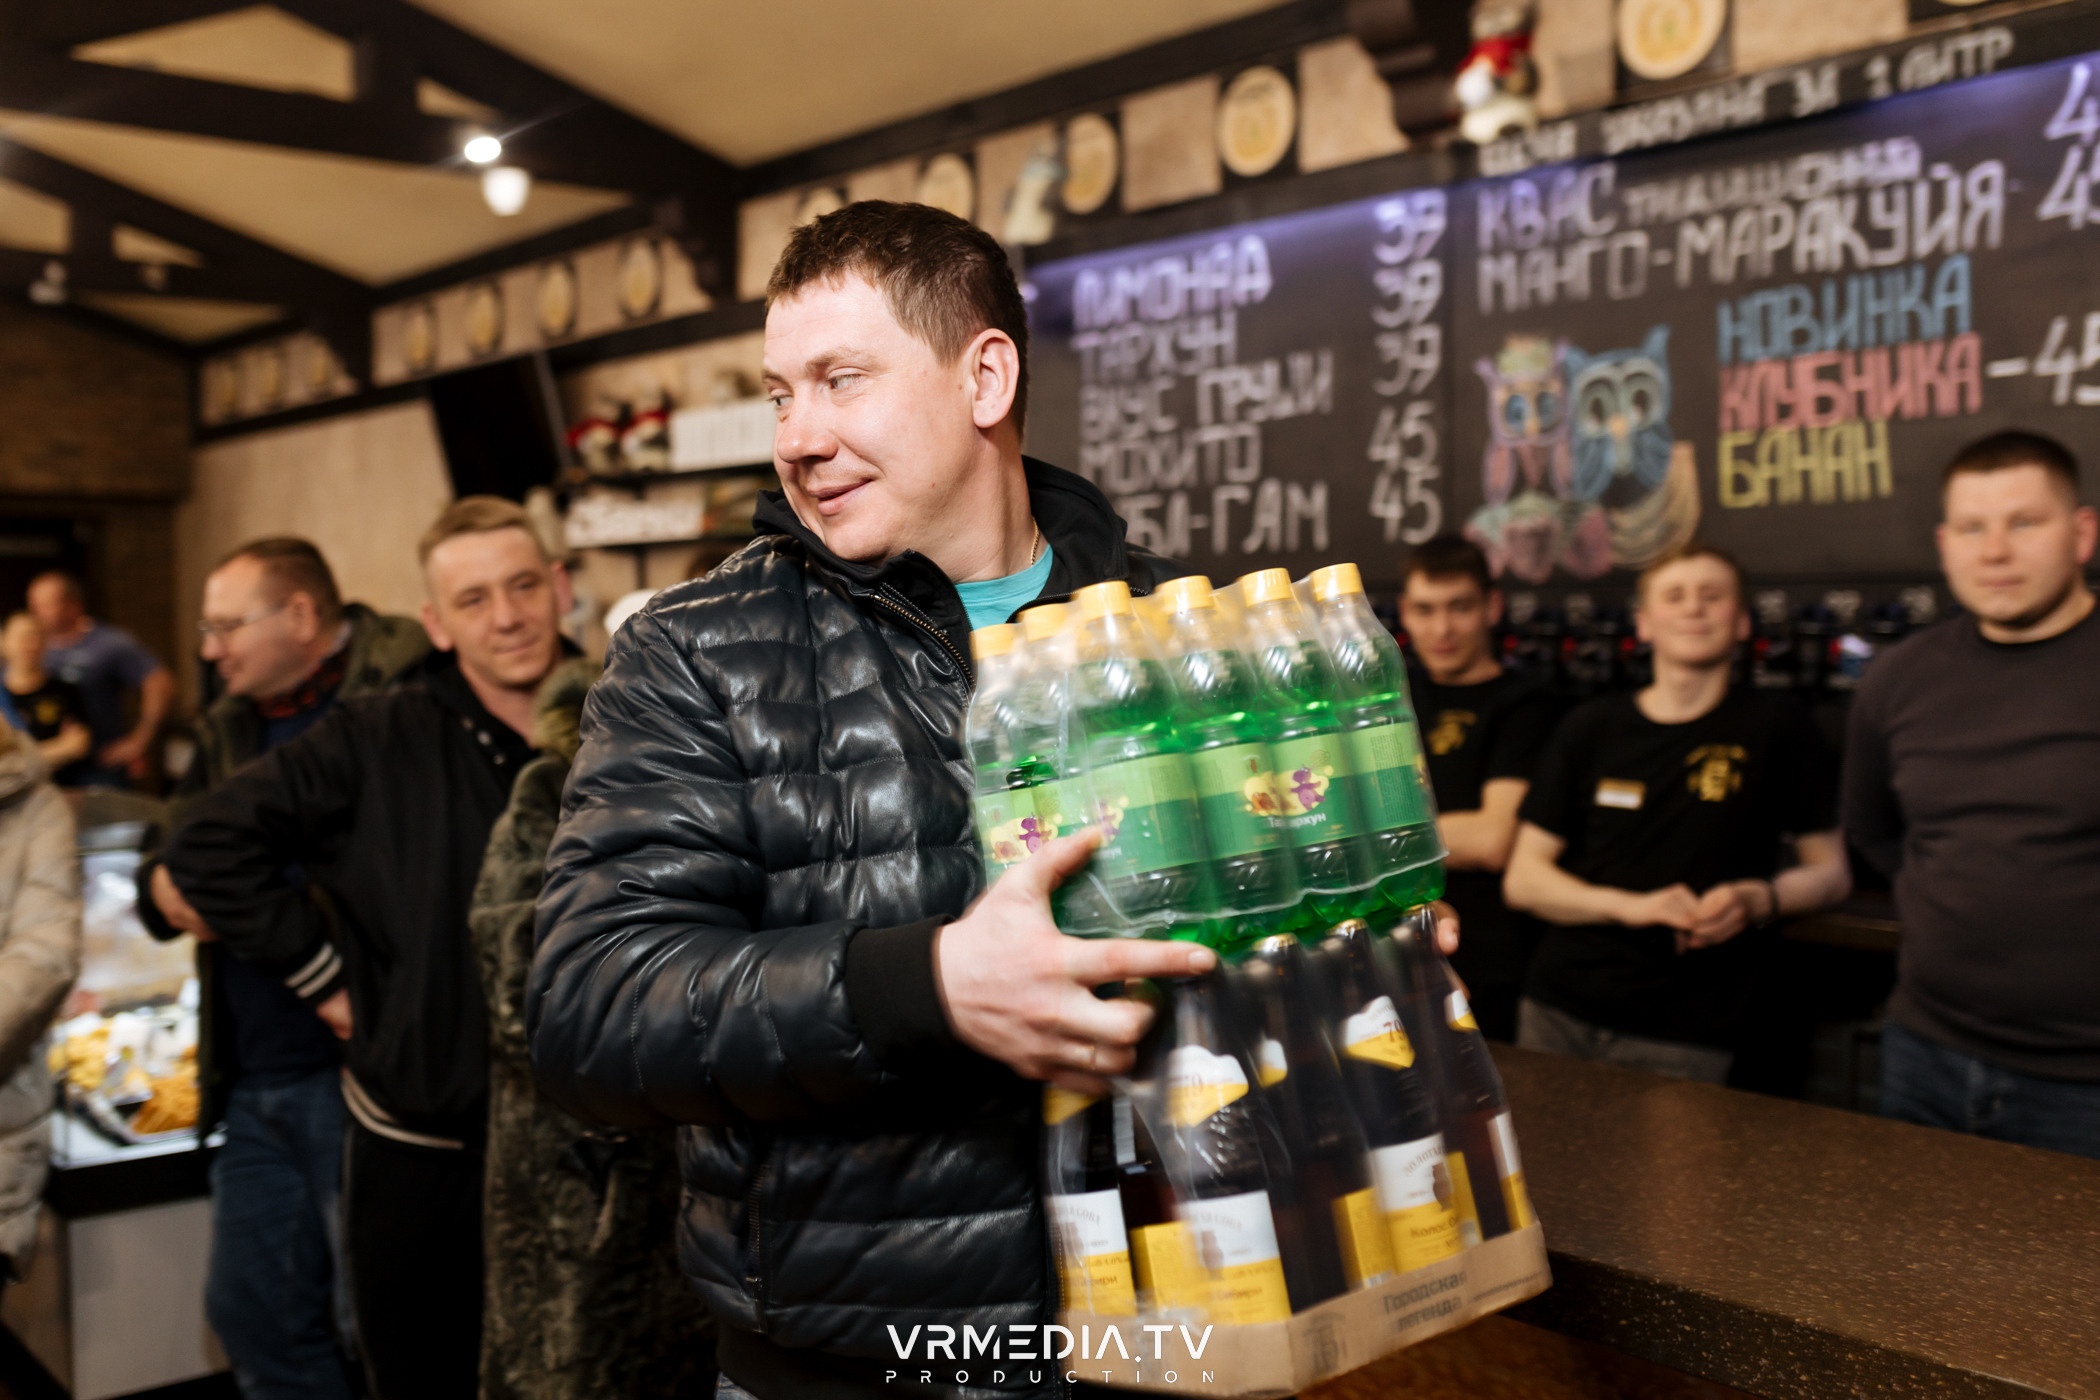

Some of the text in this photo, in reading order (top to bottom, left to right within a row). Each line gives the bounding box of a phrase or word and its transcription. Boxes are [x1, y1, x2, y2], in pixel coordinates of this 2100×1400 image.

[1372, 190, 1447, 264] 39
[1477, 161, 1617, 252] КВАС
[1371, 259, 1444, 327] 39
[1717, 252, 1973, 364] НОВИНКА
[1372, 323, 1443, 397] 39
[1718, 331, 1982, 433] КЛУБНИКА
[1368, 400, 1438, 474] 45
[1718, 421, 1892, 508] БАНАН
[1369, 467, 1443, 546] 45
[1384, 1270, 1468, 1315] Городская
